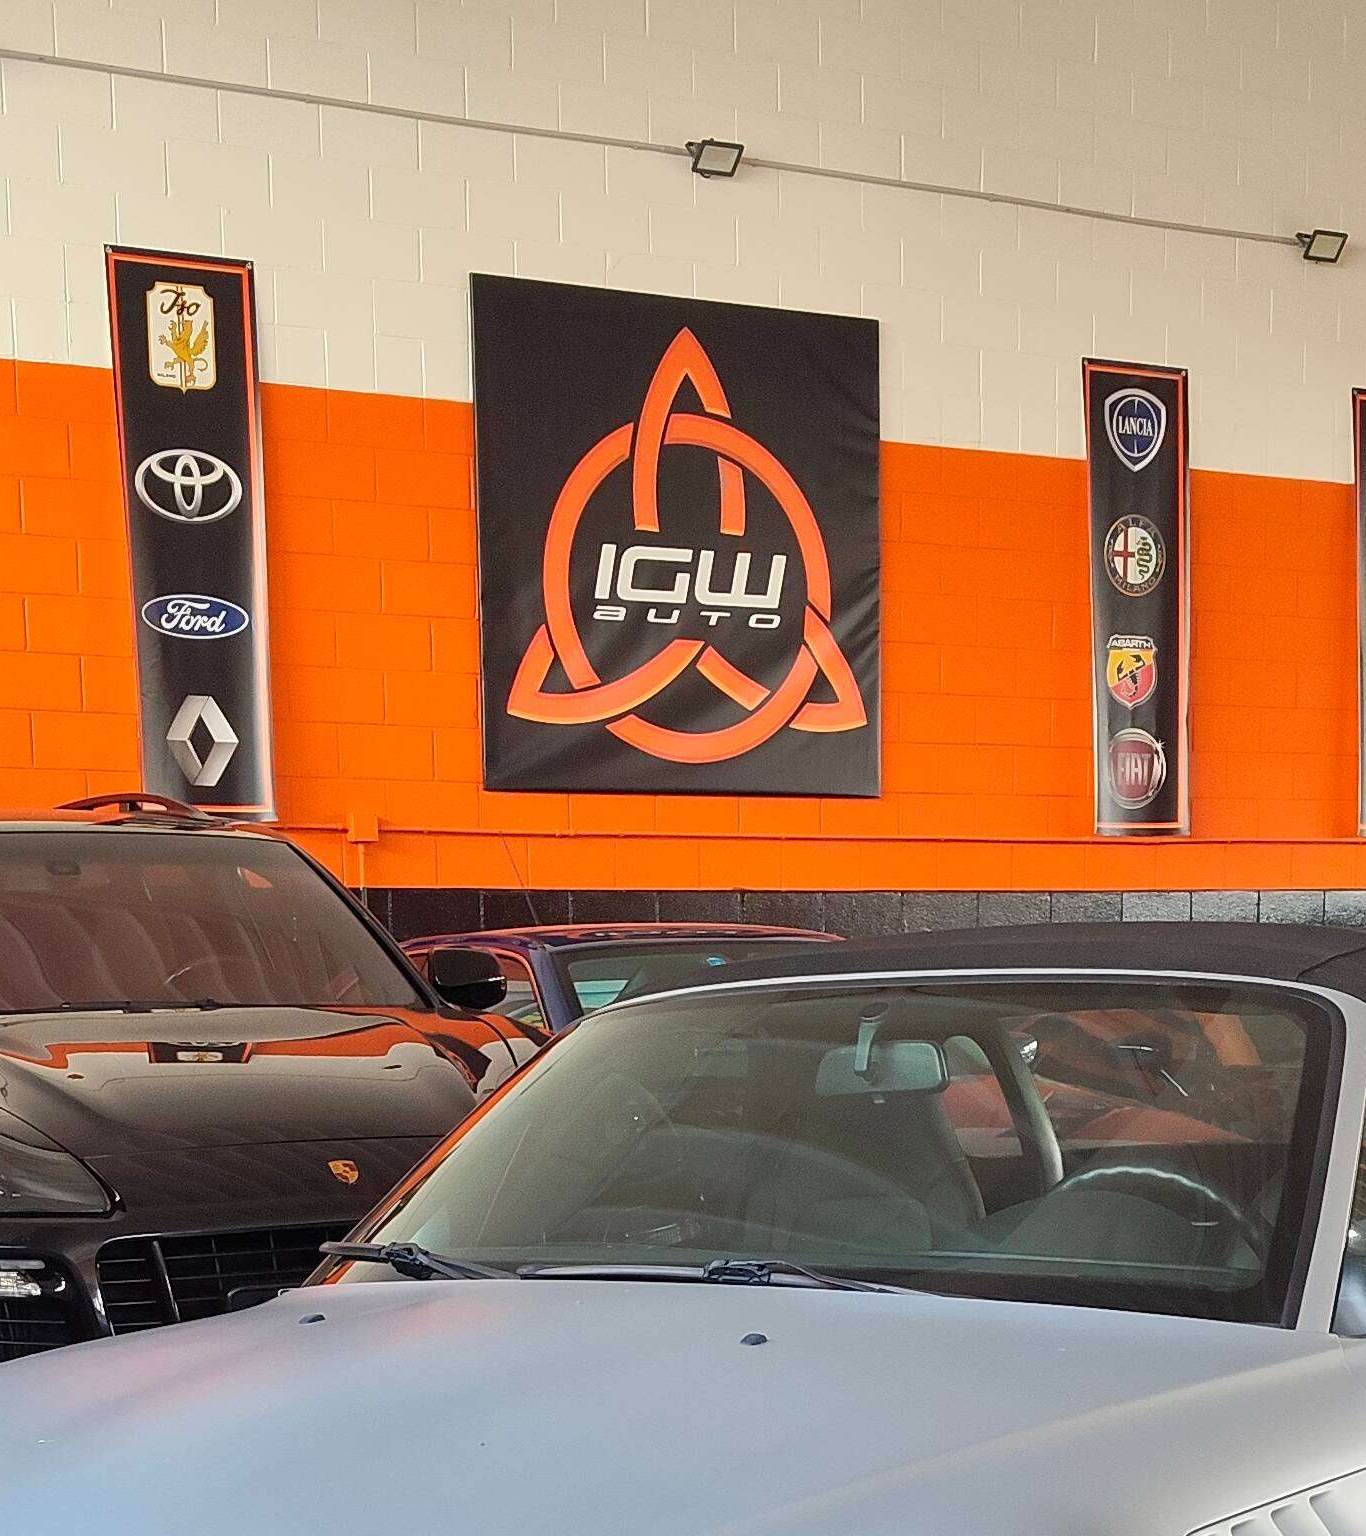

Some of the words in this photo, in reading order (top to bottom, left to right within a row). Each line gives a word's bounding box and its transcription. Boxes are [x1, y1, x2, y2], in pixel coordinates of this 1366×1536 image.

[1118, 415, 1154, 437] LANCIA
[594, 543, 787, 609] IGW
[160, 599, 227, 632] Ford
[1110, 639, 1152, 649] ABARTH
[1116, 751, 1153, 787] FIAT
